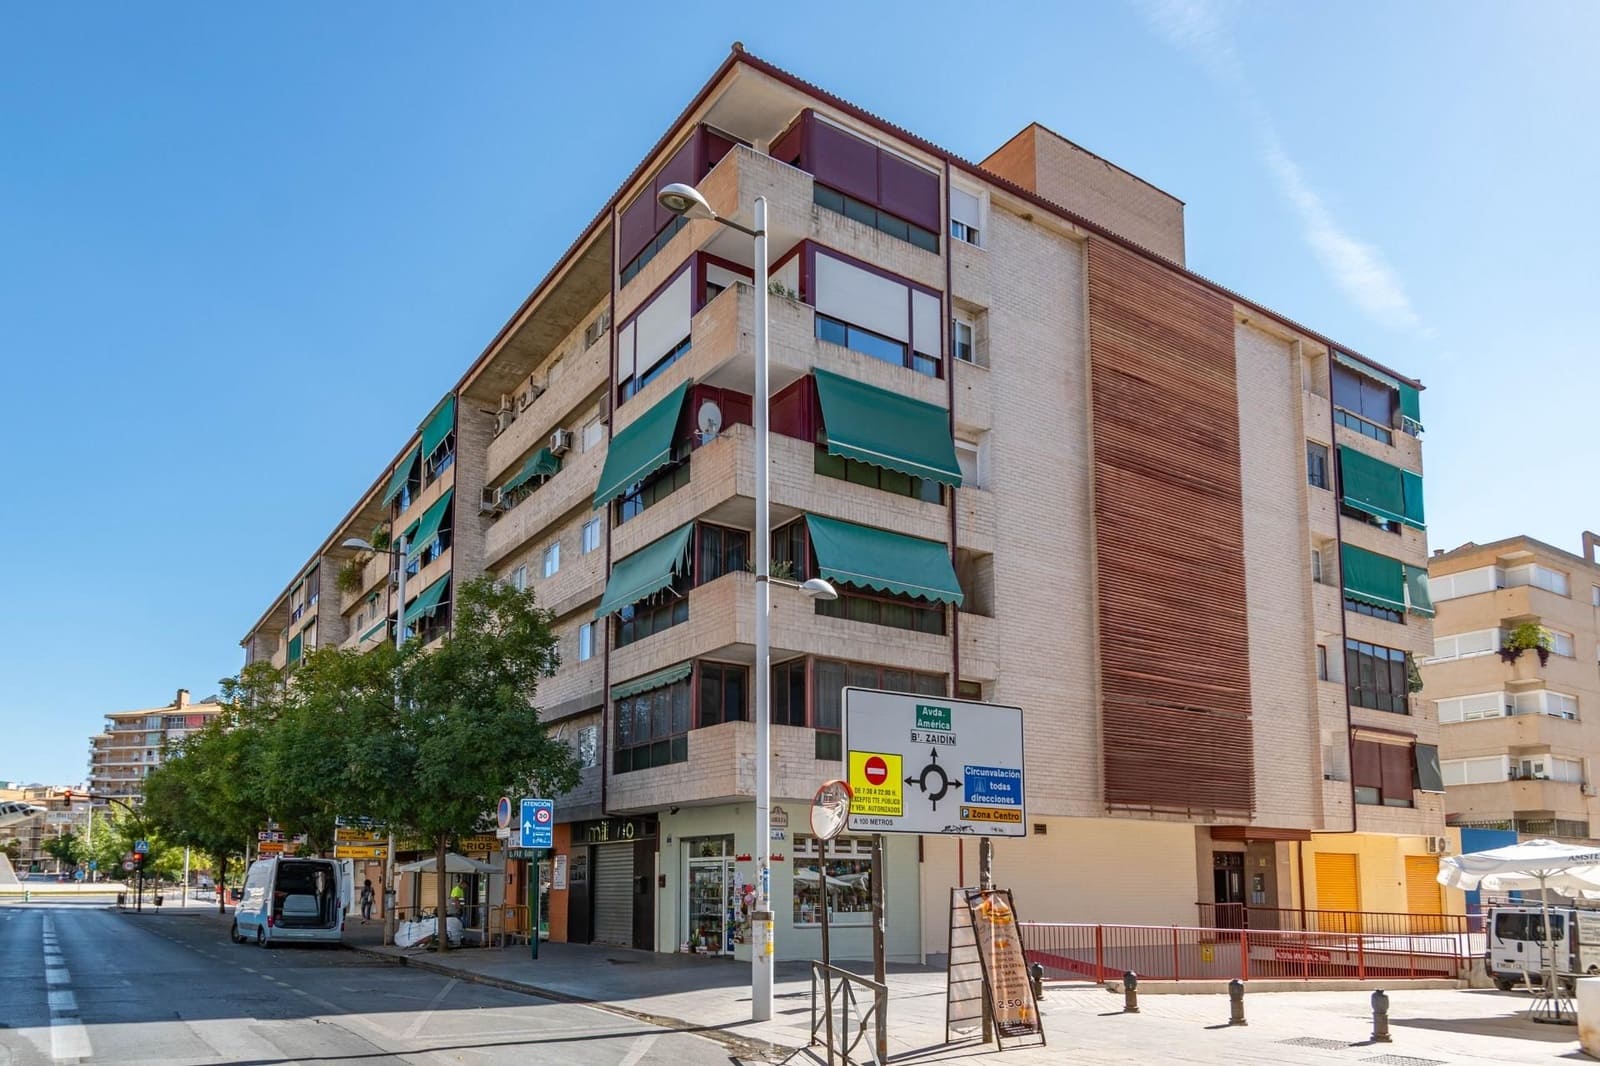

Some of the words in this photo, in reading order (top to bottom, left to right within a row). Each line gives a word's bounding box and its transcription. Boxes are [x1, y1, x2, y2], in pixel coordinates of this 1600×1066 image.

[922, 706, 946, 717] Avda.
[917, 718, 950, 730] América
[965, 766, 1020, 779] Circunvalación
[990, 781, 1011, 791] todas
[970, 793, 1015, 804] direcciones
[972, 810, 990, 818] Zona
[993, 810, 1019, 820] Centro
[870, 818, 894, 826] METROS
